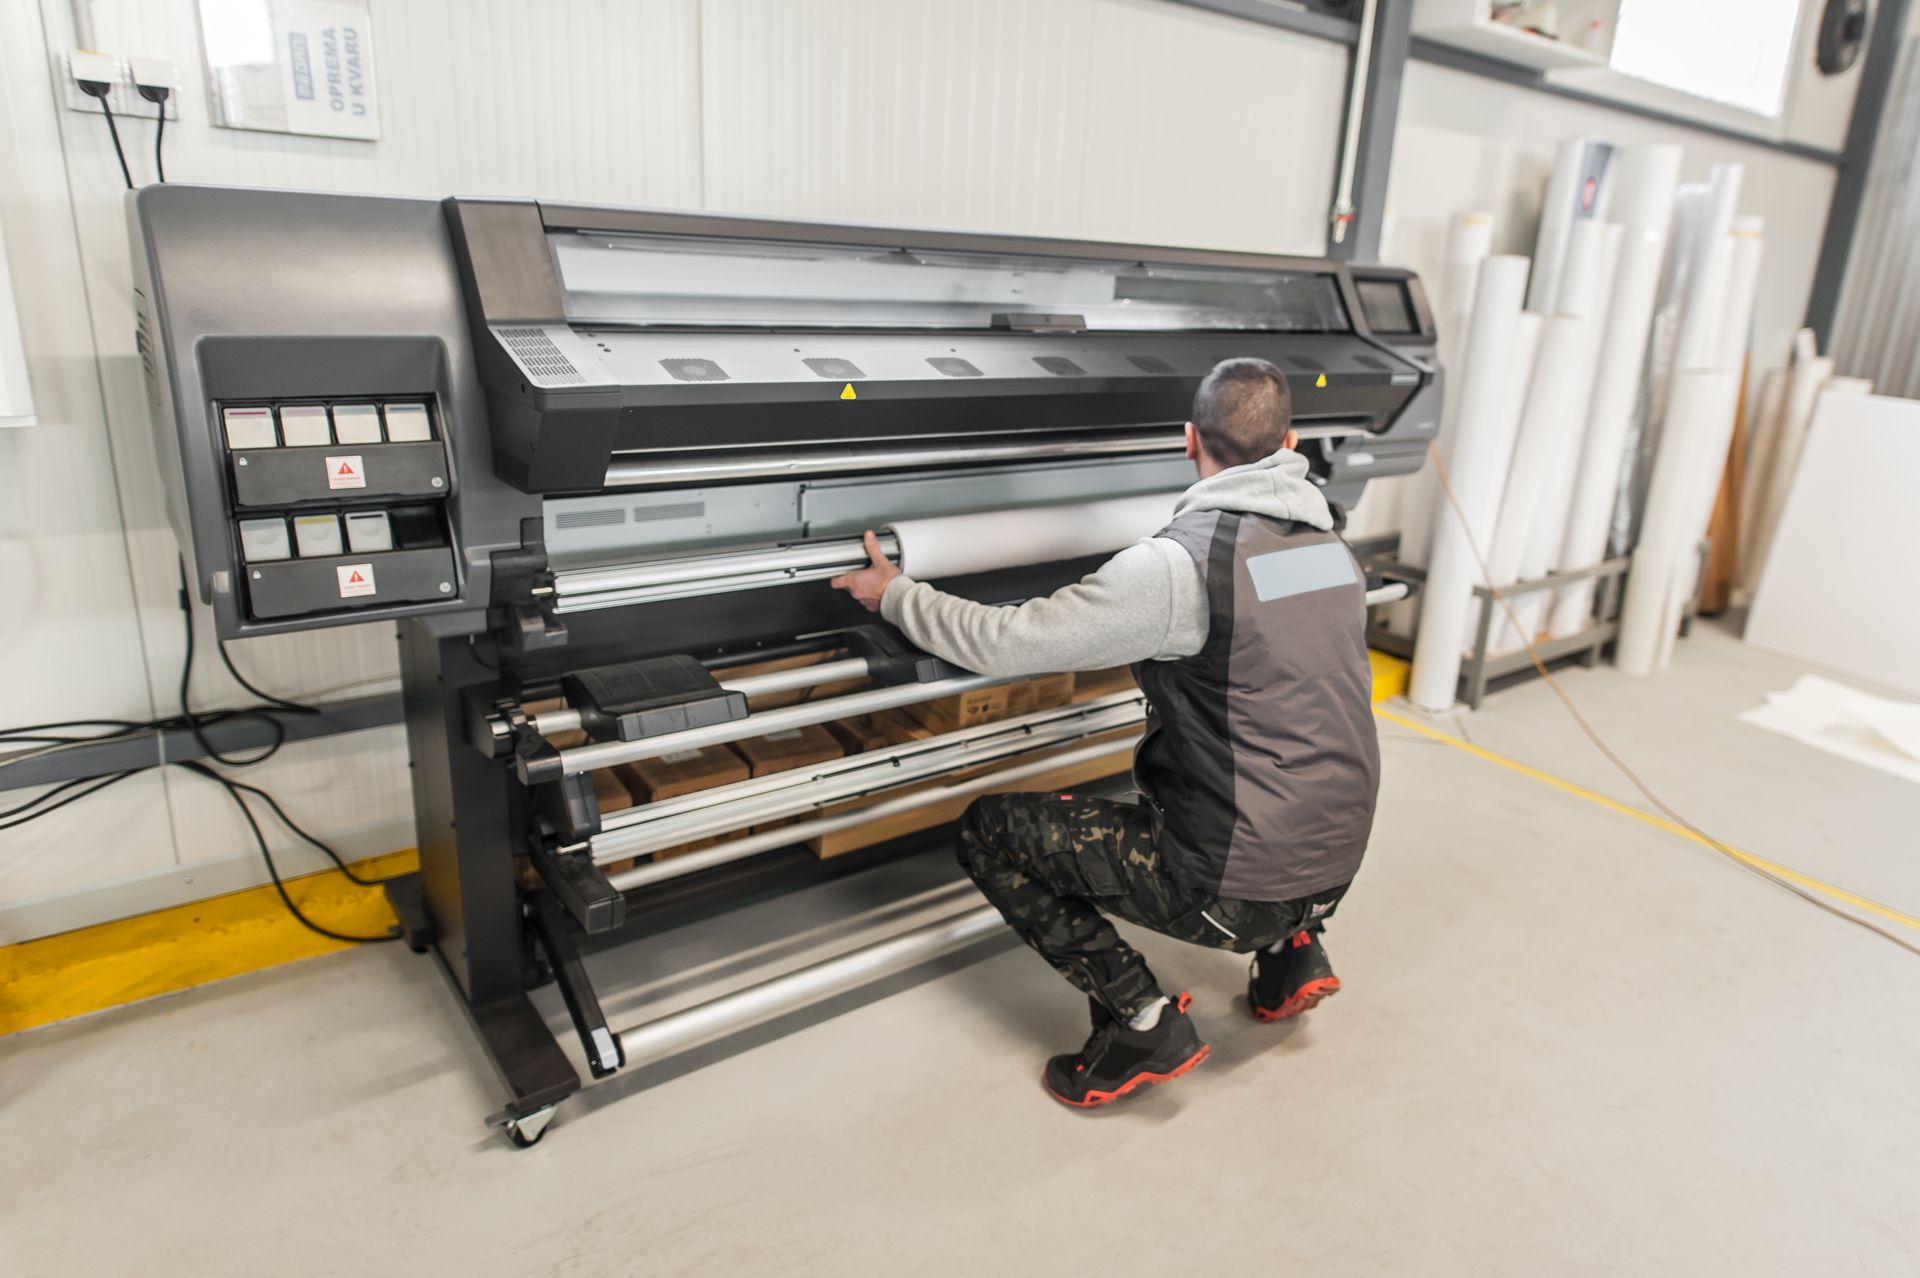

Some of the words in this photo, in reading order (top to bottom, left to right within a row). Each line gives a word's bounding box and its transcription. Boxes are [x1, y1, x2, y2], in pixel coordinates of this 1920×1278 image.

[322, 28, 344, 111] OPREMA
[343, 27, 363, 95] KVARU
[352, 103, 366, 116] U
